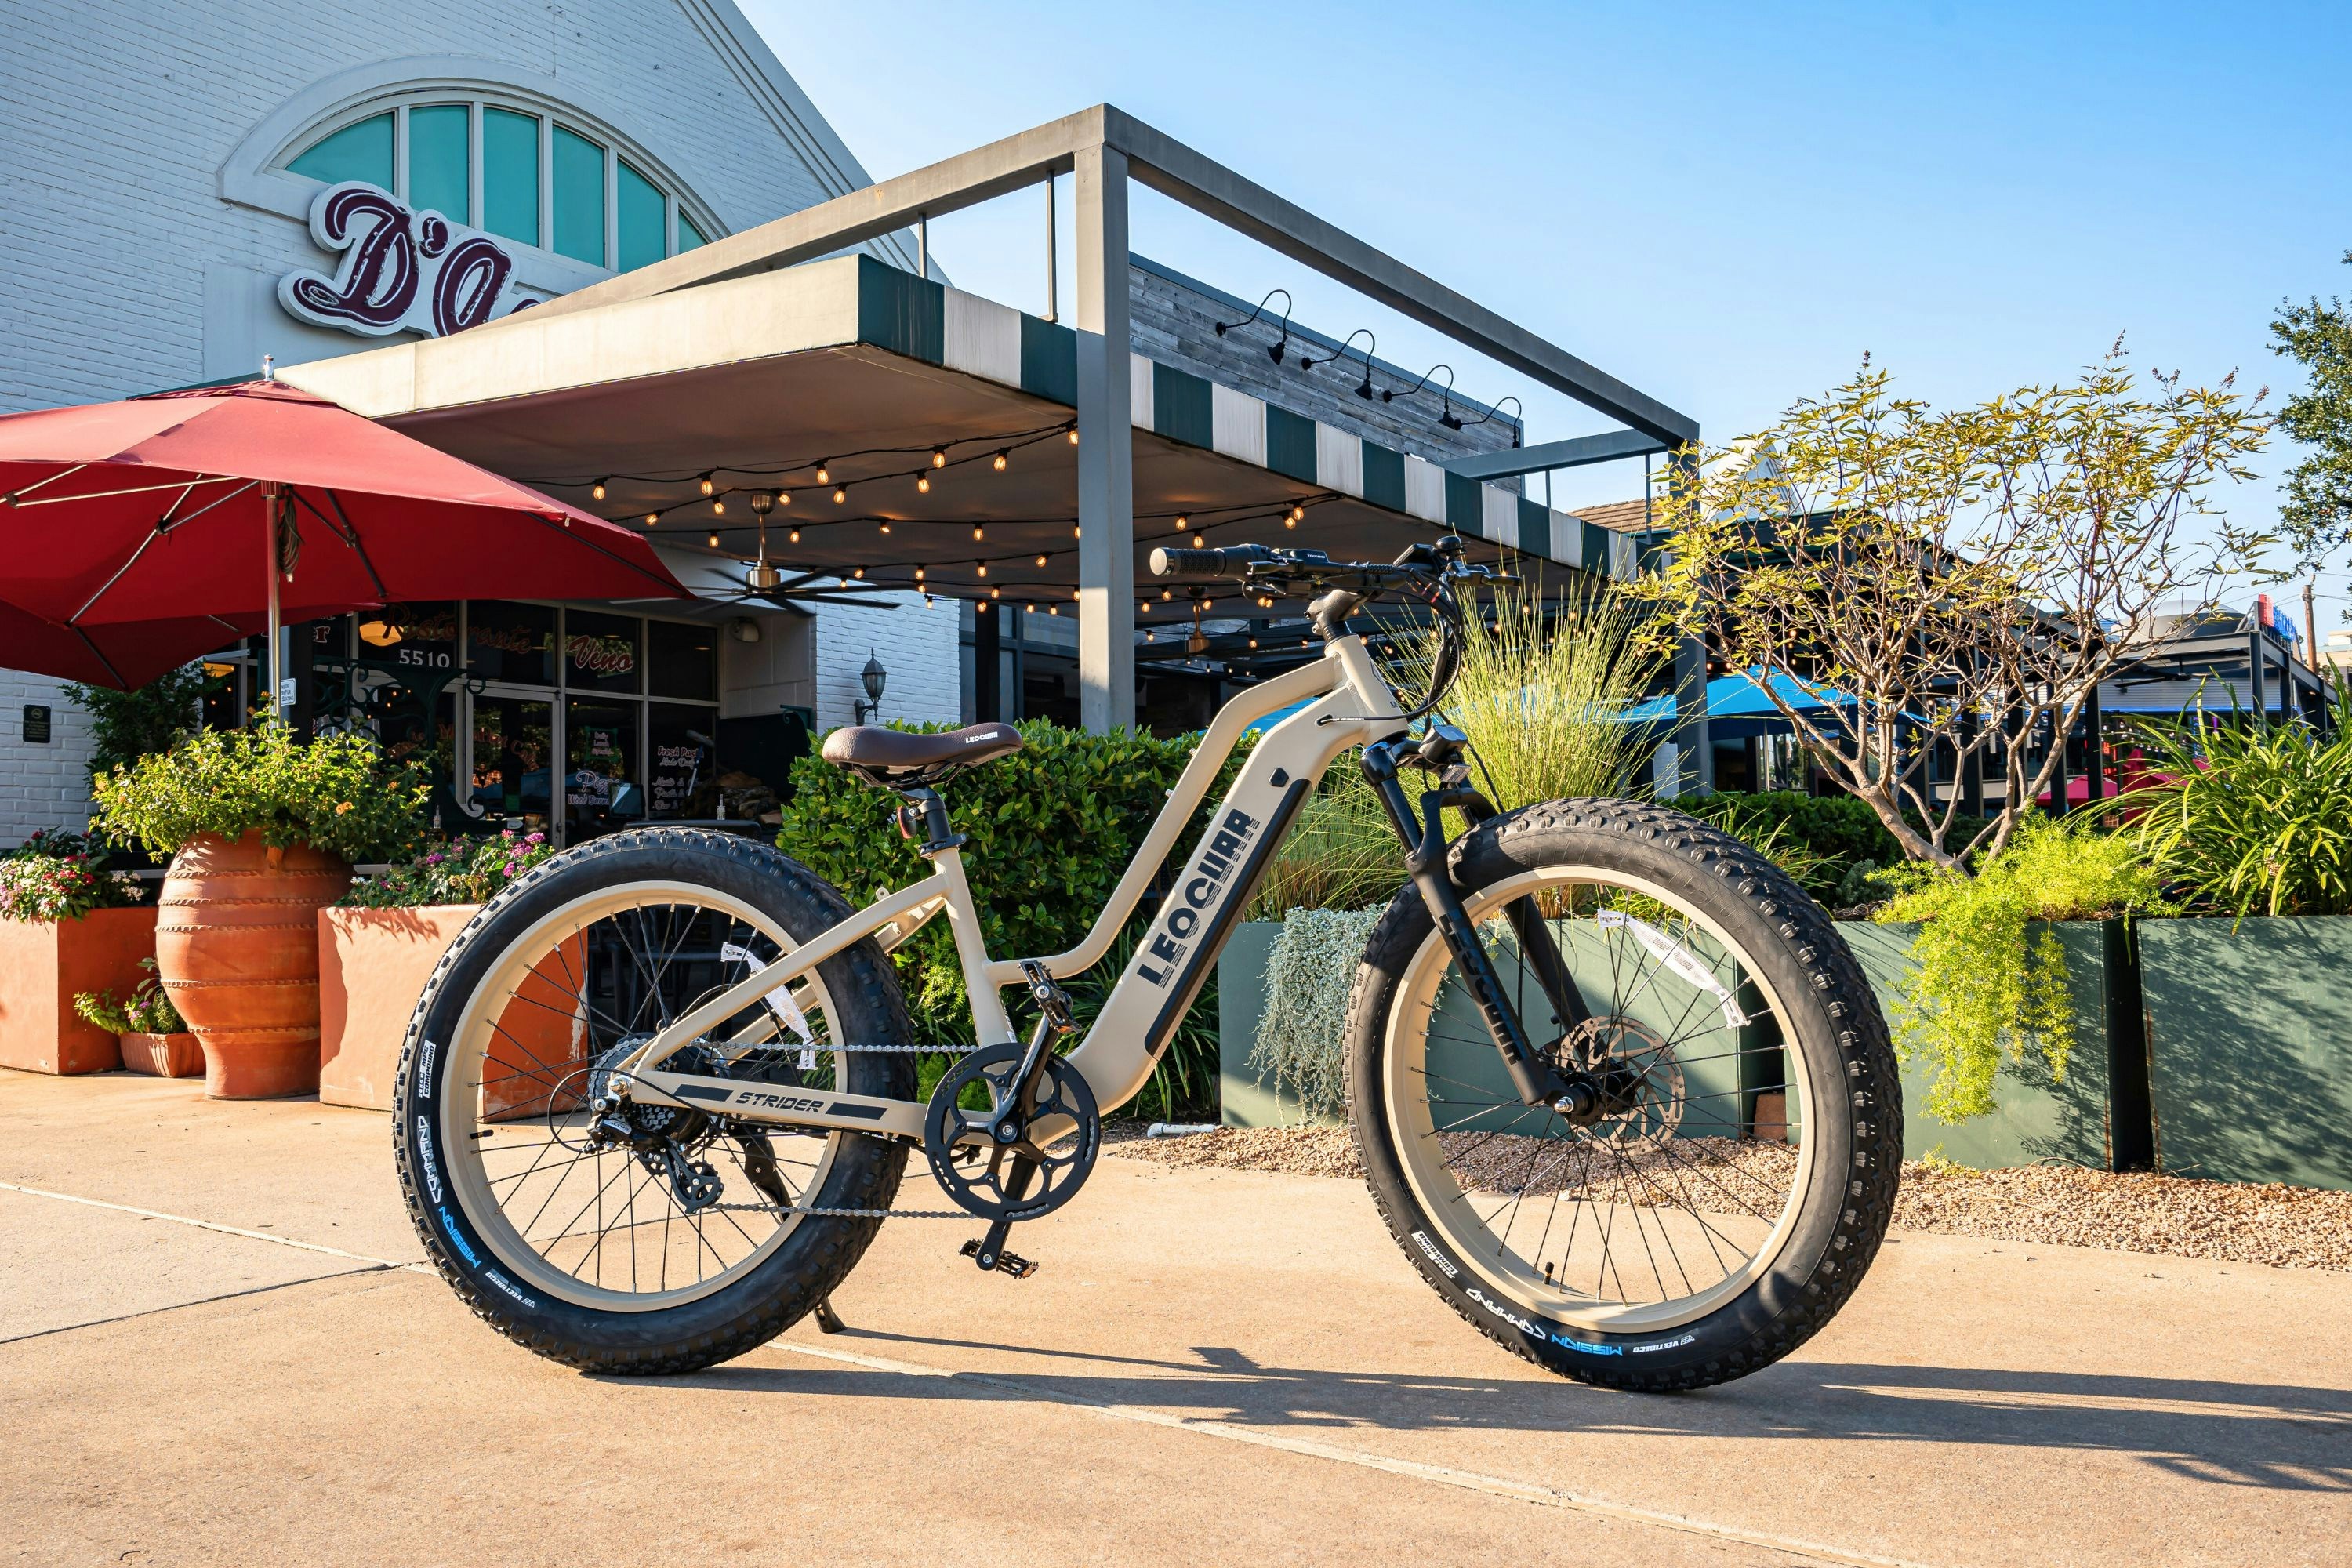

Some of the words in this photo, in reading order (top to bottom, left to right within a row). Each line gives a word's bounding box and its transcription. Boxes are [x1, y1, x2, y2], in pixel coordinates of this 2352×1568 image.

[398, 648, 450, 668] 5510
[569, 634, 634, 673] Vino
[657, 746, 680, 757] Fresh
[681, 747, 704, 758] Pas
[575, 769, 620, 795] Pizz
[567, 793, 588, 805] Wood
[1136, 808, 1261, 989] LEOGUAR
[424, 1045, 434, 1095] COMPOUND
[735, 1091, 825, 1113] STRIDER
[418, 1116, 442, 1204] COMMAND
[437, 1206, 481, 1269] MISSION
[1415, 1237, 1432, 1255] MPC
[1419, 1233, 1455, 1272] COMPOUND
[1466, 1287, 1547, 1340] COMMAND
[1551, 1333, 1624, 1356] MISSION
[1632, 1339, 1679, 1353] VEETIRECO
